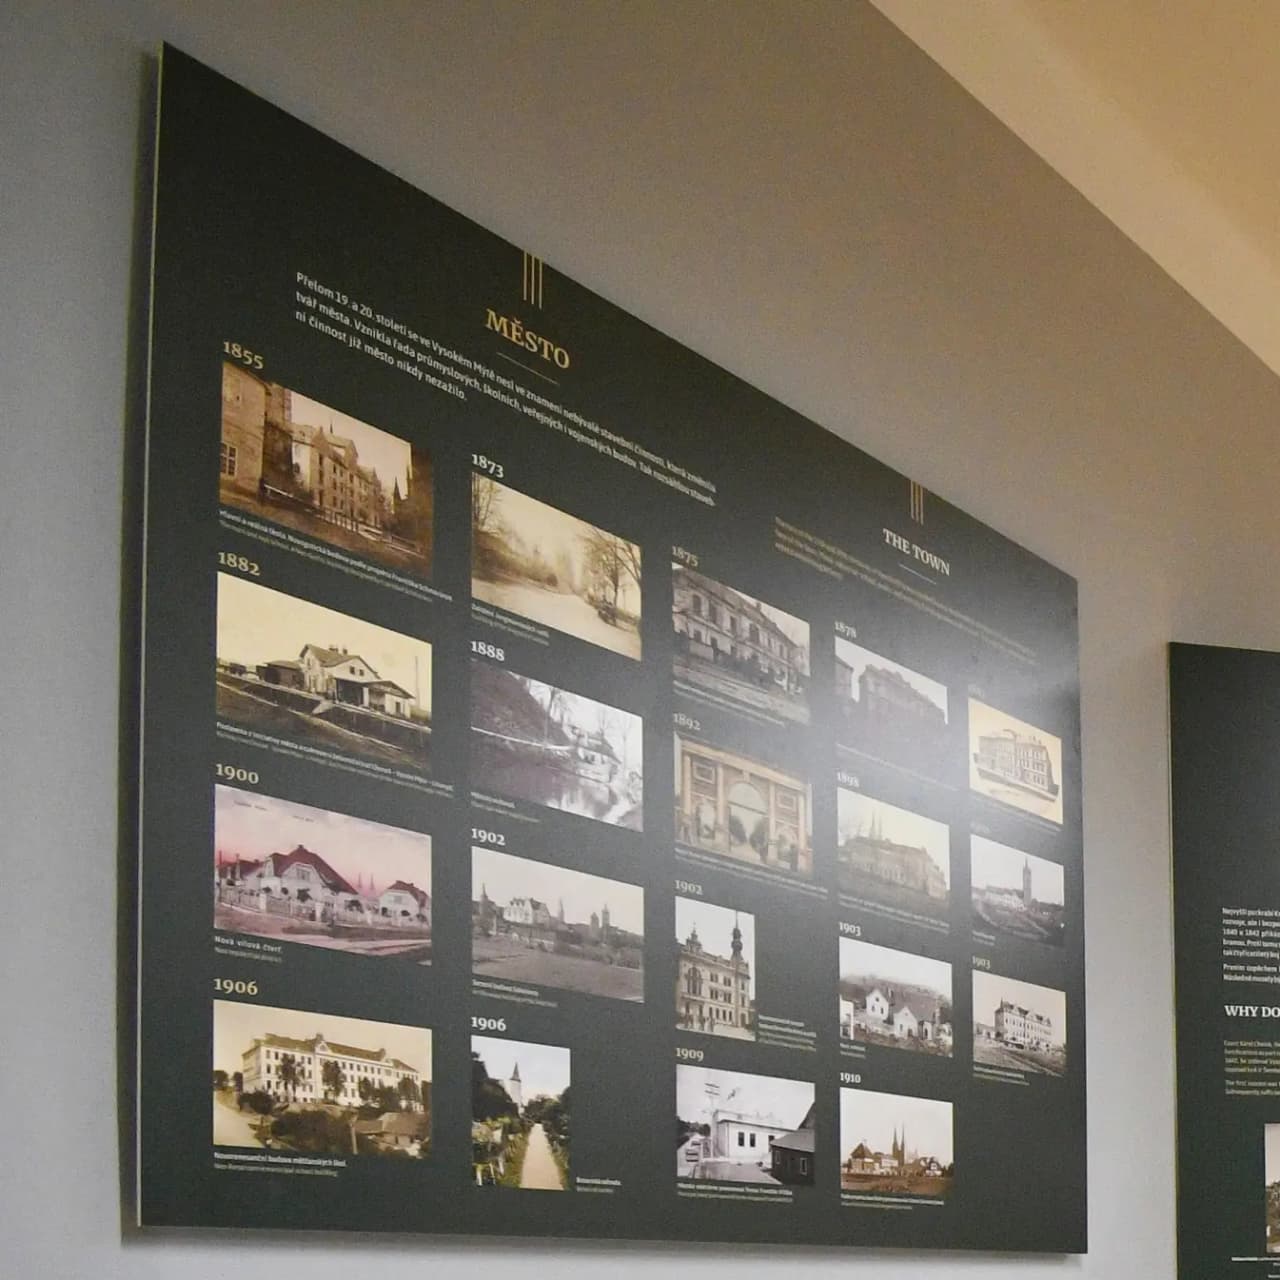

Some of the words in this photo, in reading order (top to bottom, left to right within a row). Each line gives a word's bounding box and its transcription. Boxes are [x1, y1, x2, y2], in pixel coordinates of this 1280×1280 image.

[297, 272, 334, 299] Přelom
[376, 315, 406, 335] století
[309, 316, 346, 342] činnost
[365, 344, 394, 364] město
[397, 361, 423, 380] nikdy
[486, 309, 569, 368] MĚSTO
[223, 341, 264, 369] 1855
[472, 454, 505, 477] 1873
[673, 546, 698, 567] 1875
[883, 529, 910, 554] THE
[912, 544, 949, 576] TOWN
[470, 641, 505, 661] 1888
[215, 764, 259, 784] 1900
[471, 828, 505, 846] 1902
[675, 880, 703, 894] 1902
[839, 921, 861, 935] 1903
[215, 979, 257, 995] 1906
[1225, 1006, 1257, 1016] WHY
[471, 1016, 506, 1031] 1906
[676, 1047, 703, 1062] 1909
[839, 1072, 861, 1084] 1910
